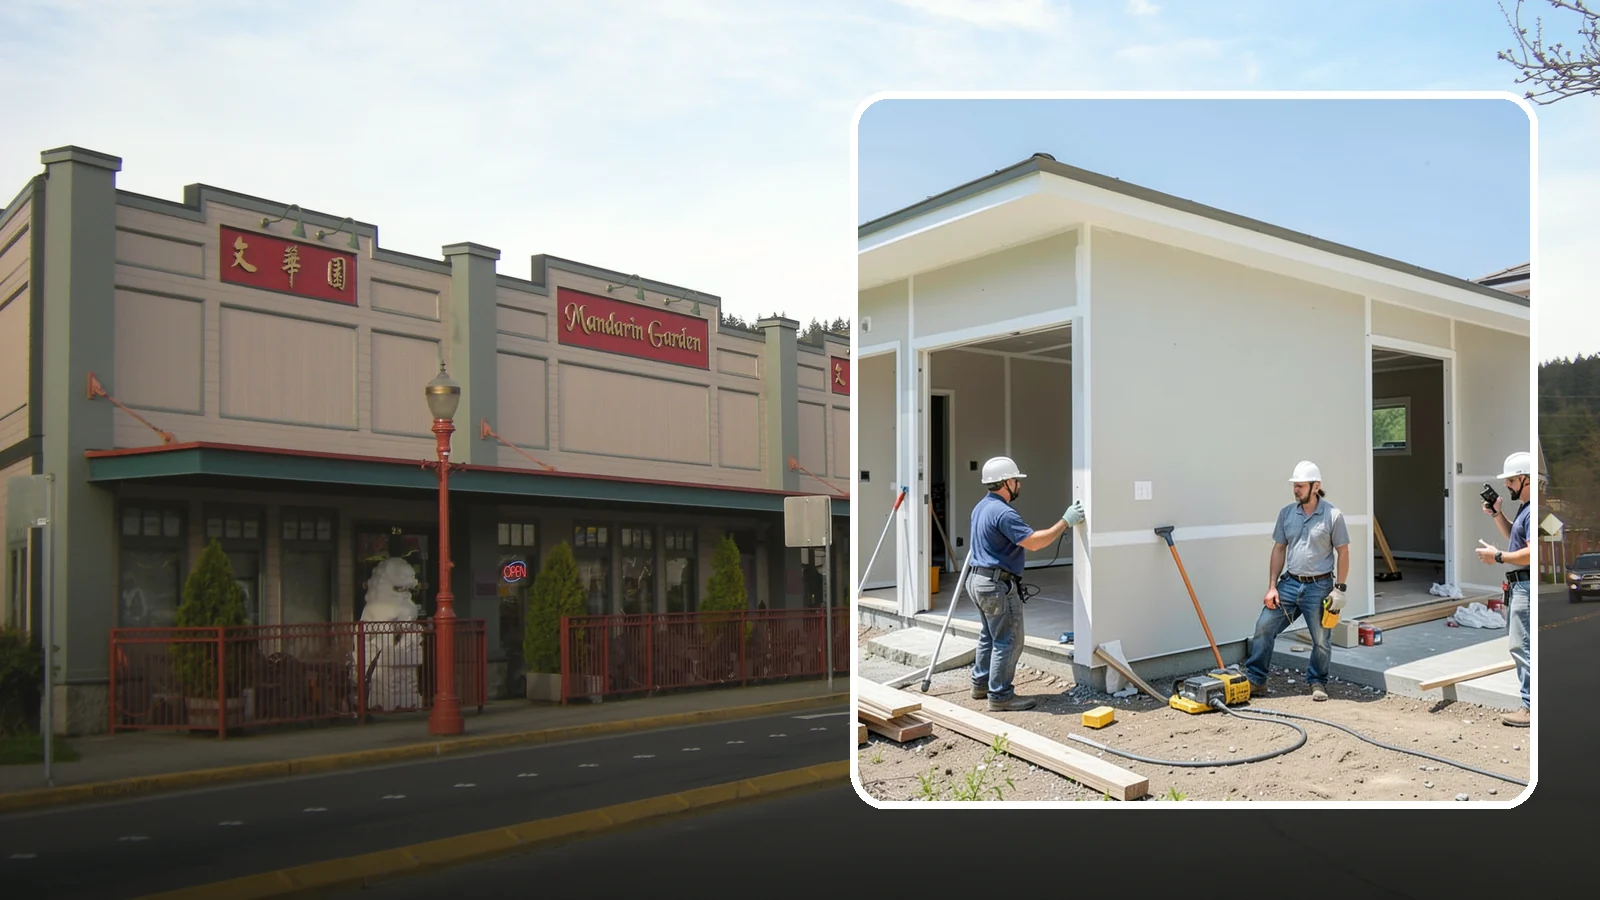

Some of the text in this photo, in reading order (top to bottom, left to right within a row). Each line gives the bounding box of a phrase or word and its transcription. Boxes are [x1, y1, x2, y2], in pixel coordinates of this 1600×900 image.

[230, 235, 346, 291] 文華園
[564, 302, 701, 352] Mandarin Garden
[503, 565, 527, 578] OPEN
